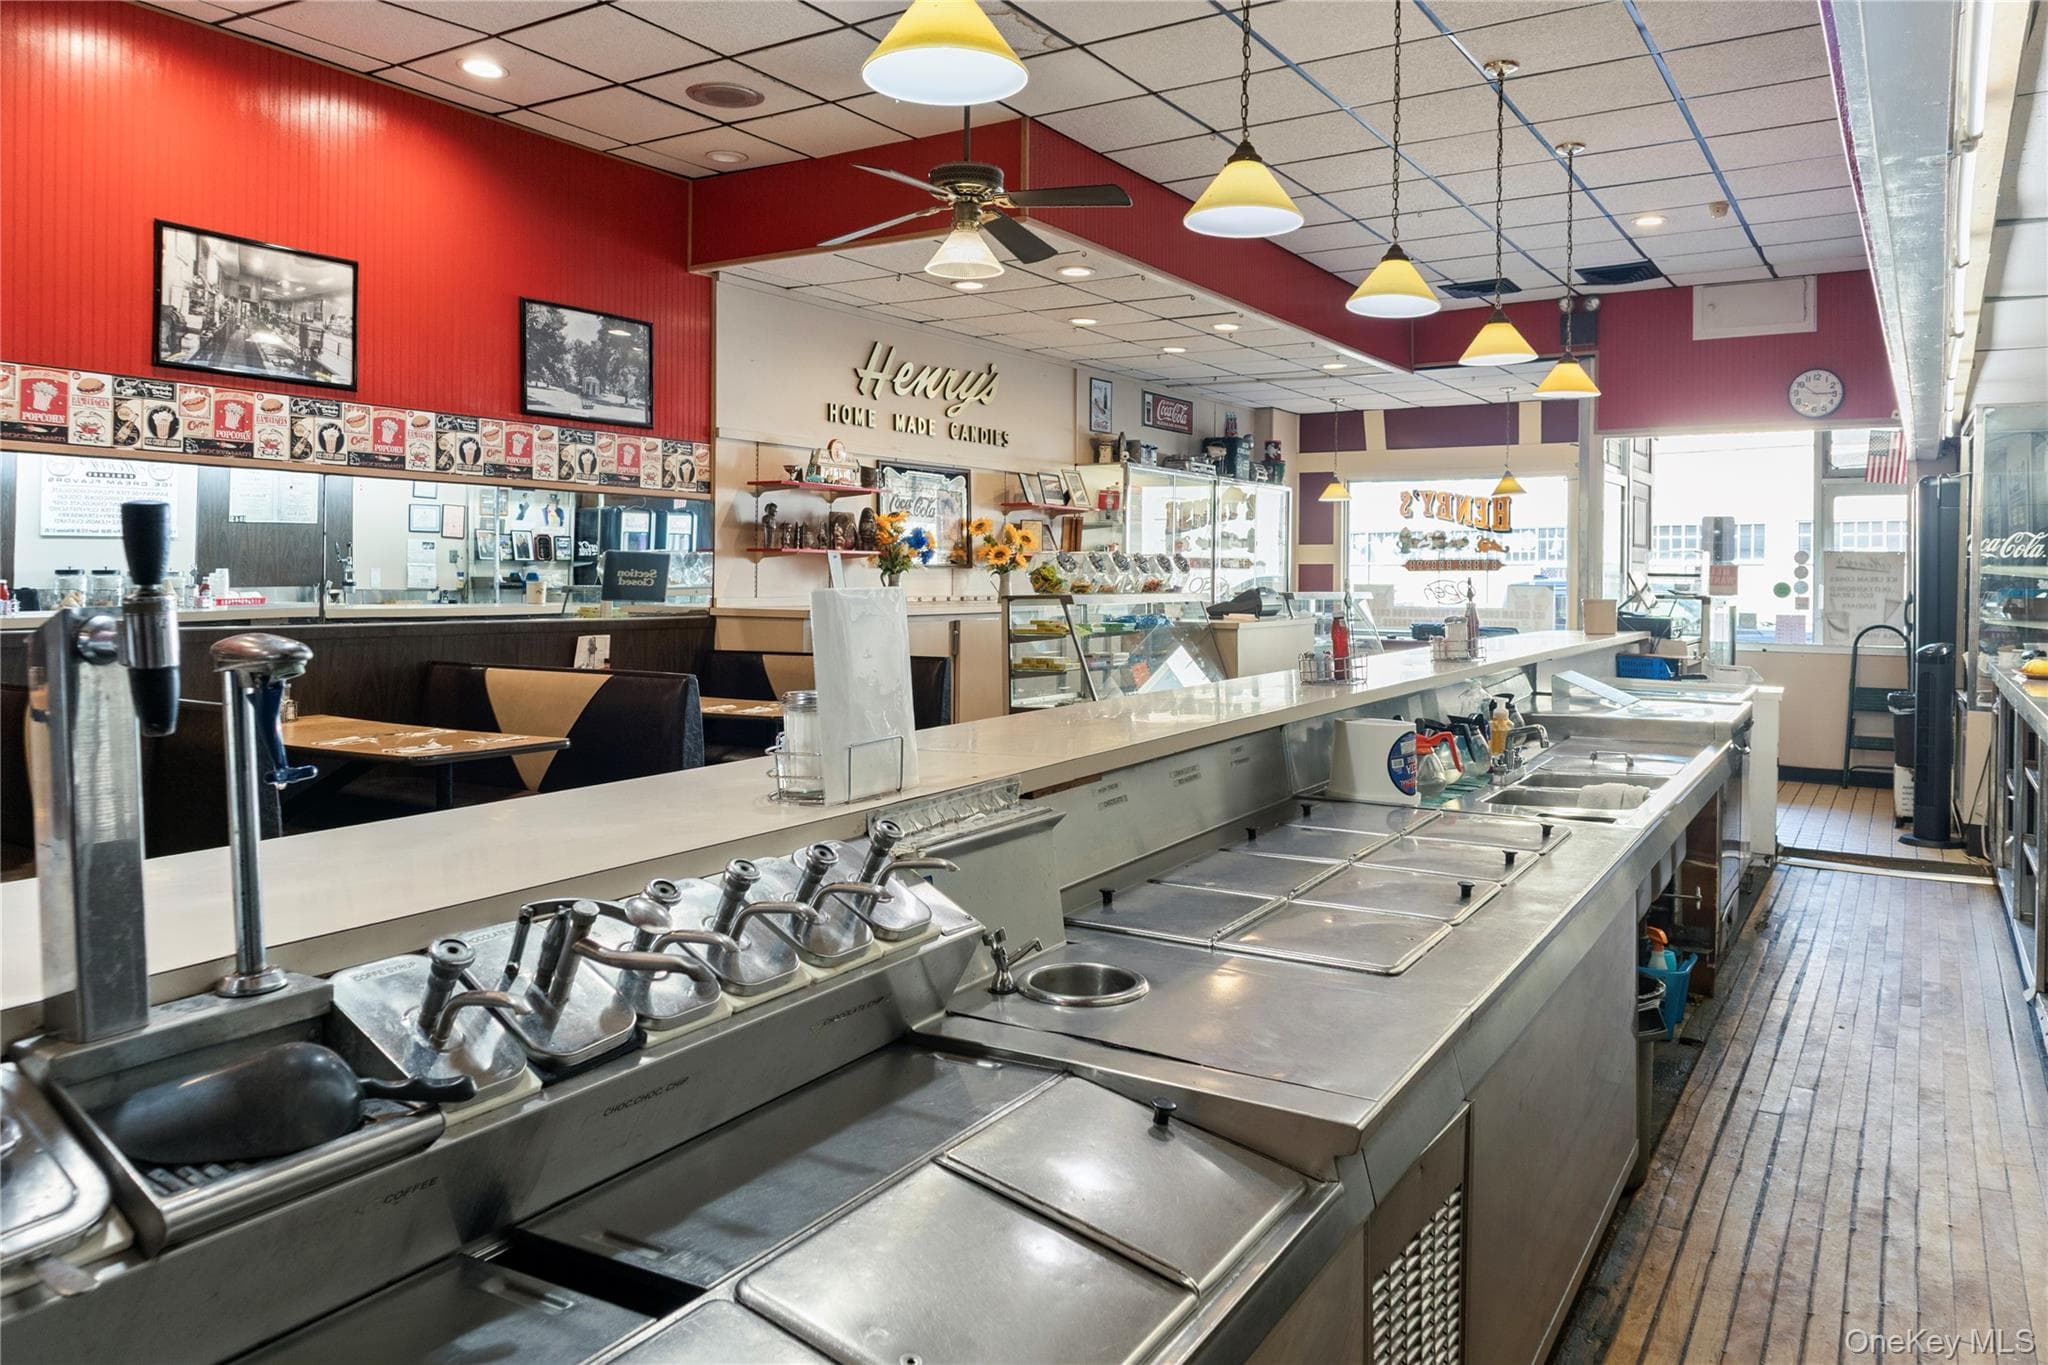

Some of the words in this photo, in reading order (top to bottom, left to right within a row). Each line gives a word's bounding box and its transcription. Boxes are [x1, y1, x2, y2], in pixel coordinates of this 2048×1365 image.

[855, 341, 1000, 417] Henry's
[21, 411, 65, 425] POPCORN
[827, 403, 876, 429] HOME
[893, 414, 937, 437] MADE
[950, 422, 1010, 448] CANDIES
[215, 428, 251, 441] POPCORN
[374, 443, 404, 454] POPCORN
[505, 456, 531, 466] POPCORN
[1966, 531, 2048, 559] ca-Cola
[383, 1175, 439, 1204] COFFEE
